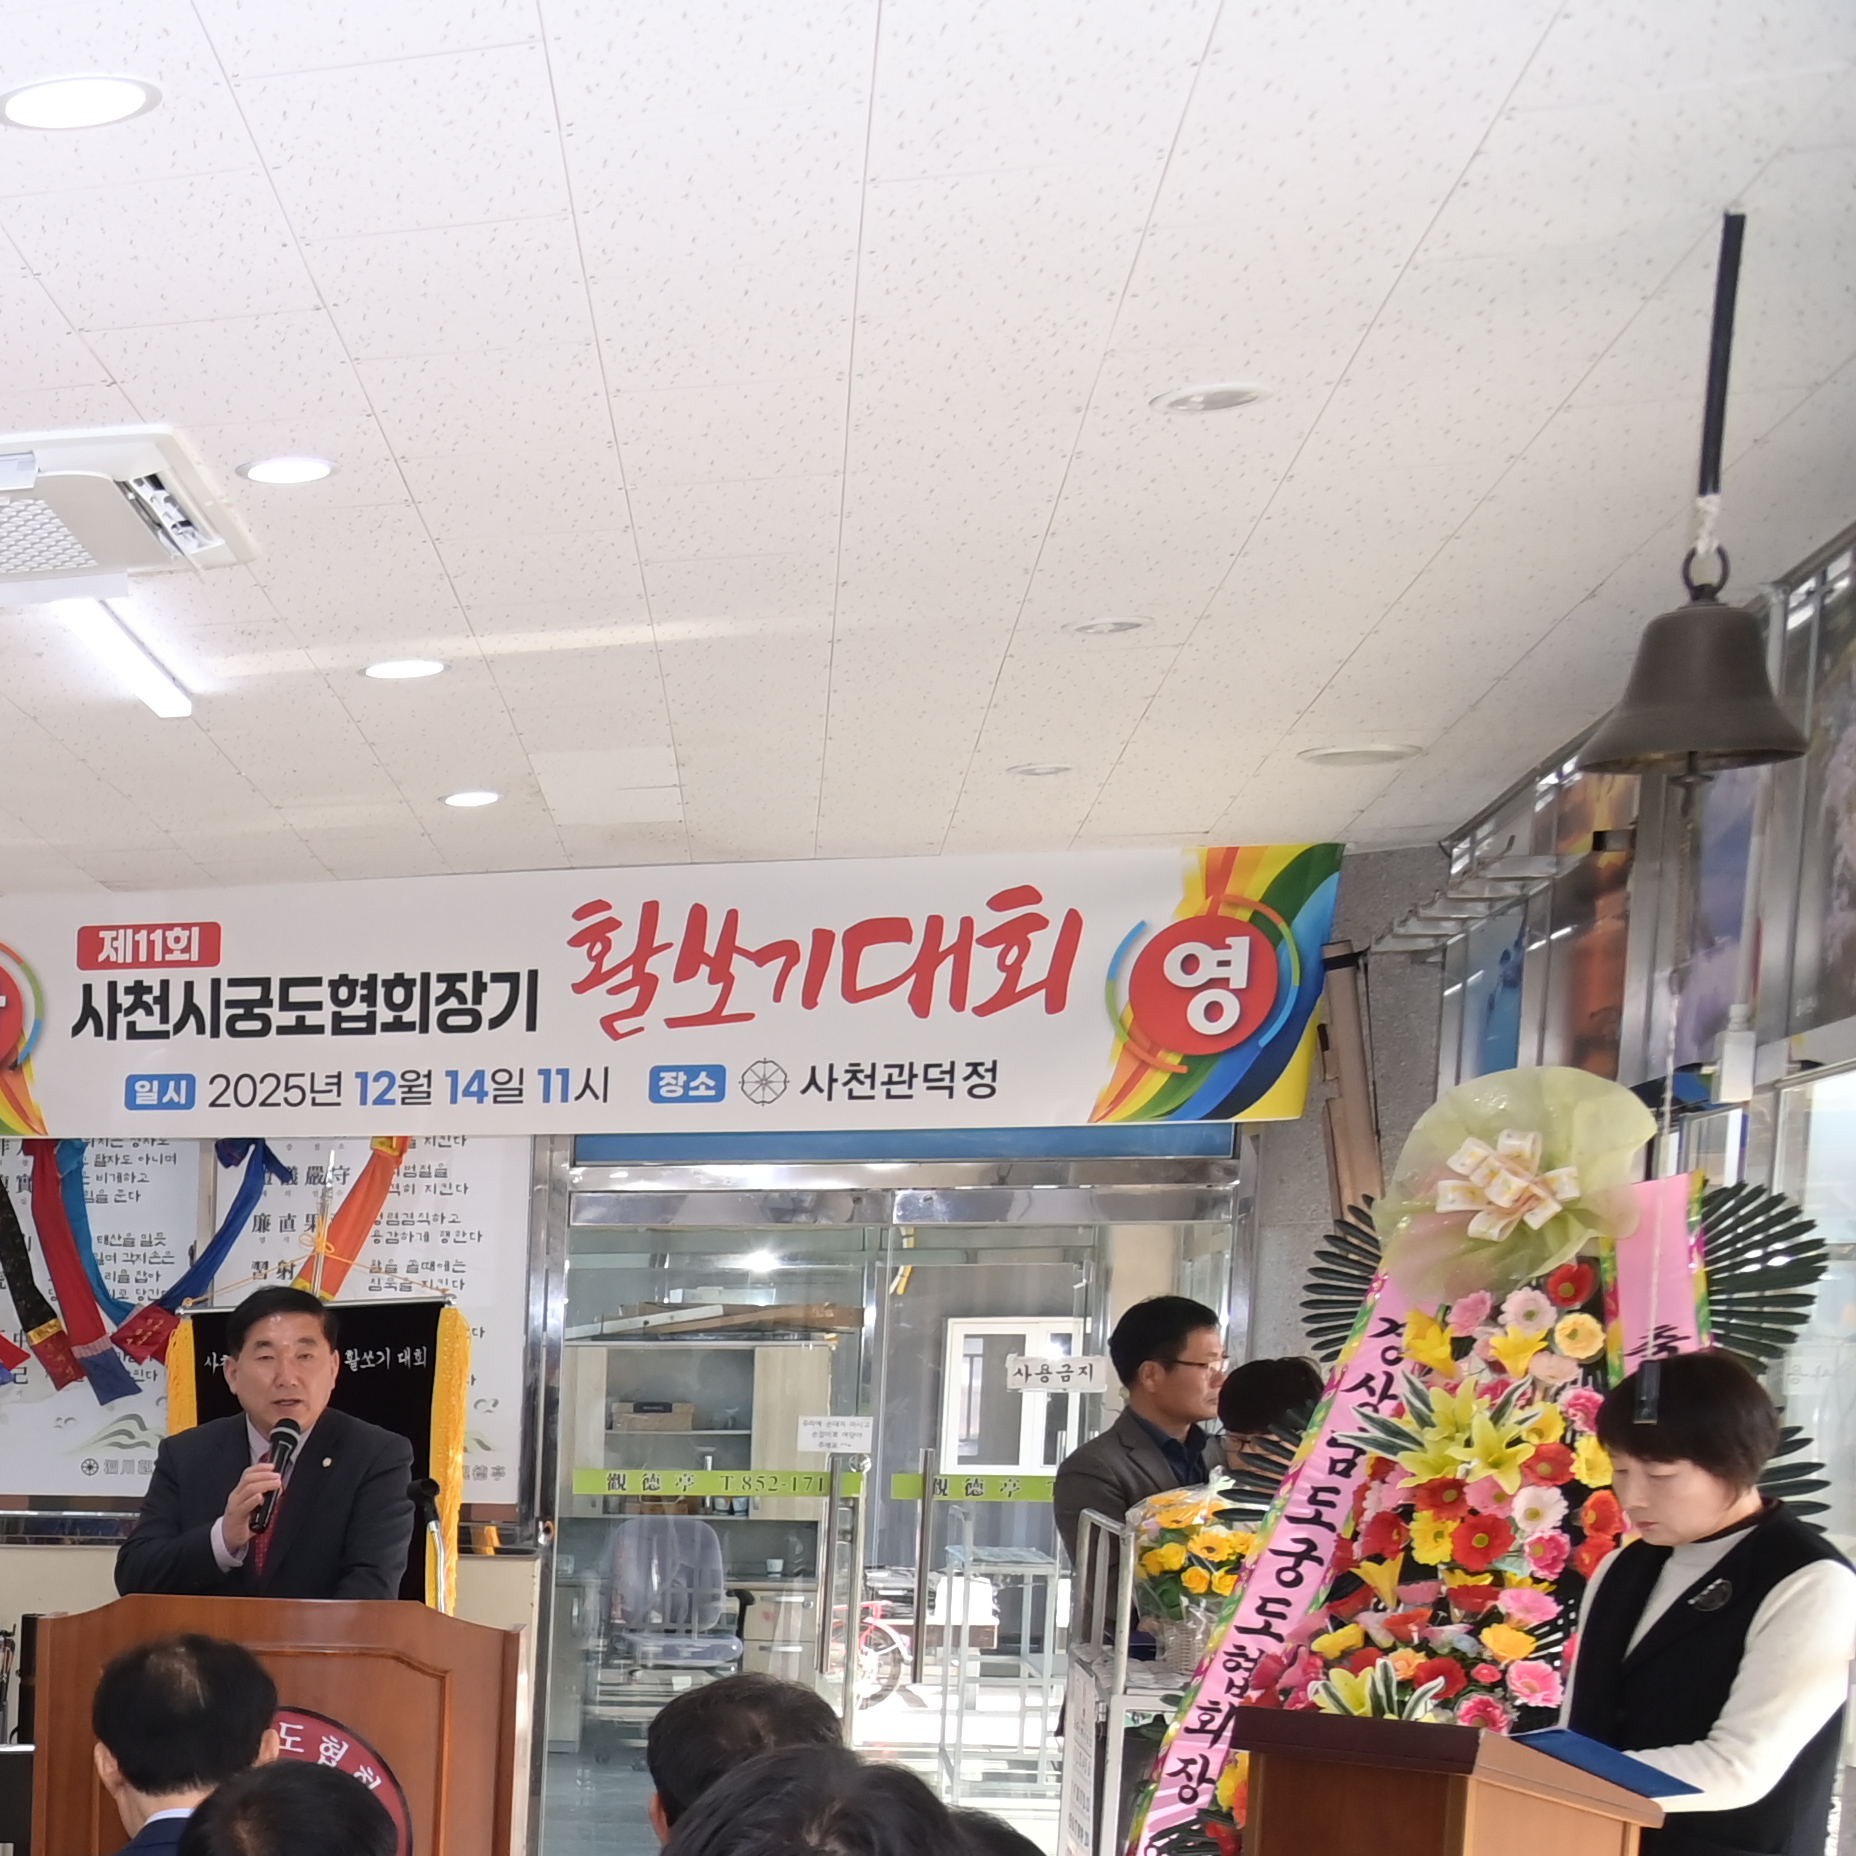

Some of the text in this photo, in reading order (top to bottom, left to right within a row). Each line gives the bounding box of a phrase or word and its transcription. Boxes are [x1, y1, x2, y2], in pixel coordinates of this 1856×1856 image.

[71, 884, 1083, 1041] 사천시궁도협회장기 활쏘기대회
[98, 928, 200, 964] 제11회
[1163, 934, 1252, 1036] 영
[133, 1066, 609, 1109] 일시 2025년 12월 14일 11시
[658, 1060, 999, 1101] 장소 사천관덕정
[425, 1183, 469, 1196] 지킨다
[344, 1347, 390, 1372] 활쏘기
[397, 1346, 427, 1369] 대회
[1013, 1364, 1094, 1383] 사용금지
